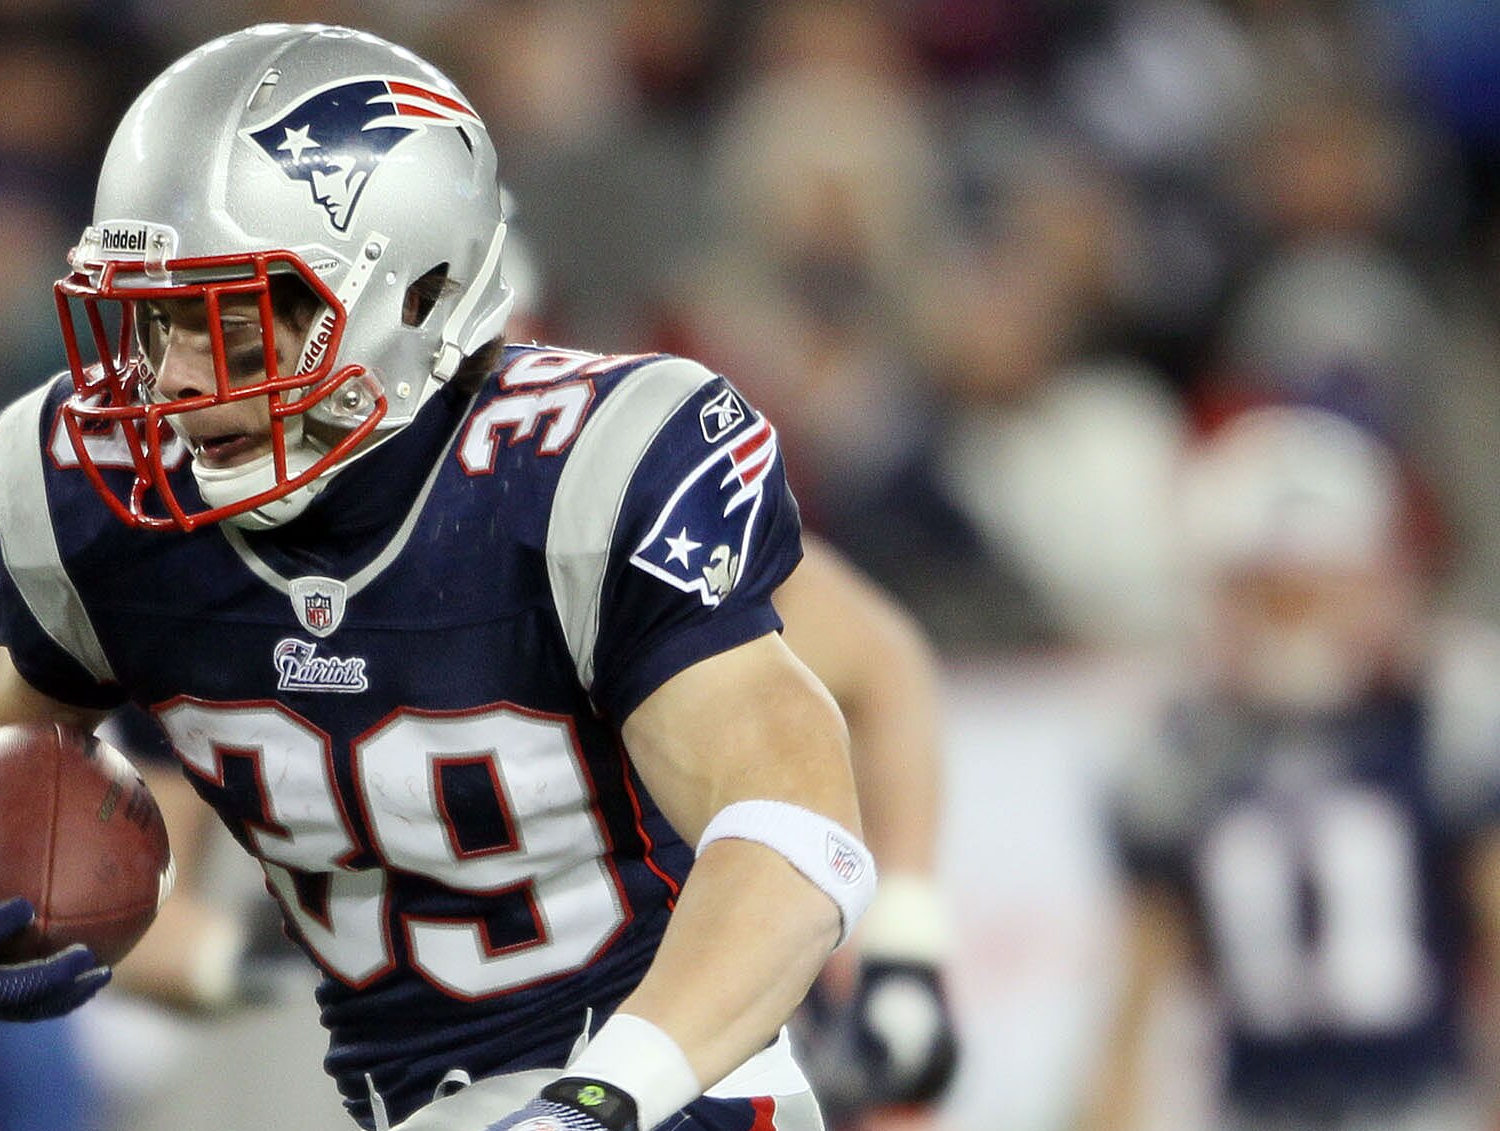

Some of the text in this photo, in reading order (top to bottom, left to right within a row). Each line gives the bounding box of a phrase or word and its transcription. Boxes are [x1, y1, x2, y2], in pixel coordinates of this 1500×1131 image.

[102, 228, 147, 250] Riddell
[297, 315, 336, 377] ddell
[307, 608, 330, 627] NFL
[278, 653, 366, 691] Patriots
[151, 694, 634, 1002] 39
